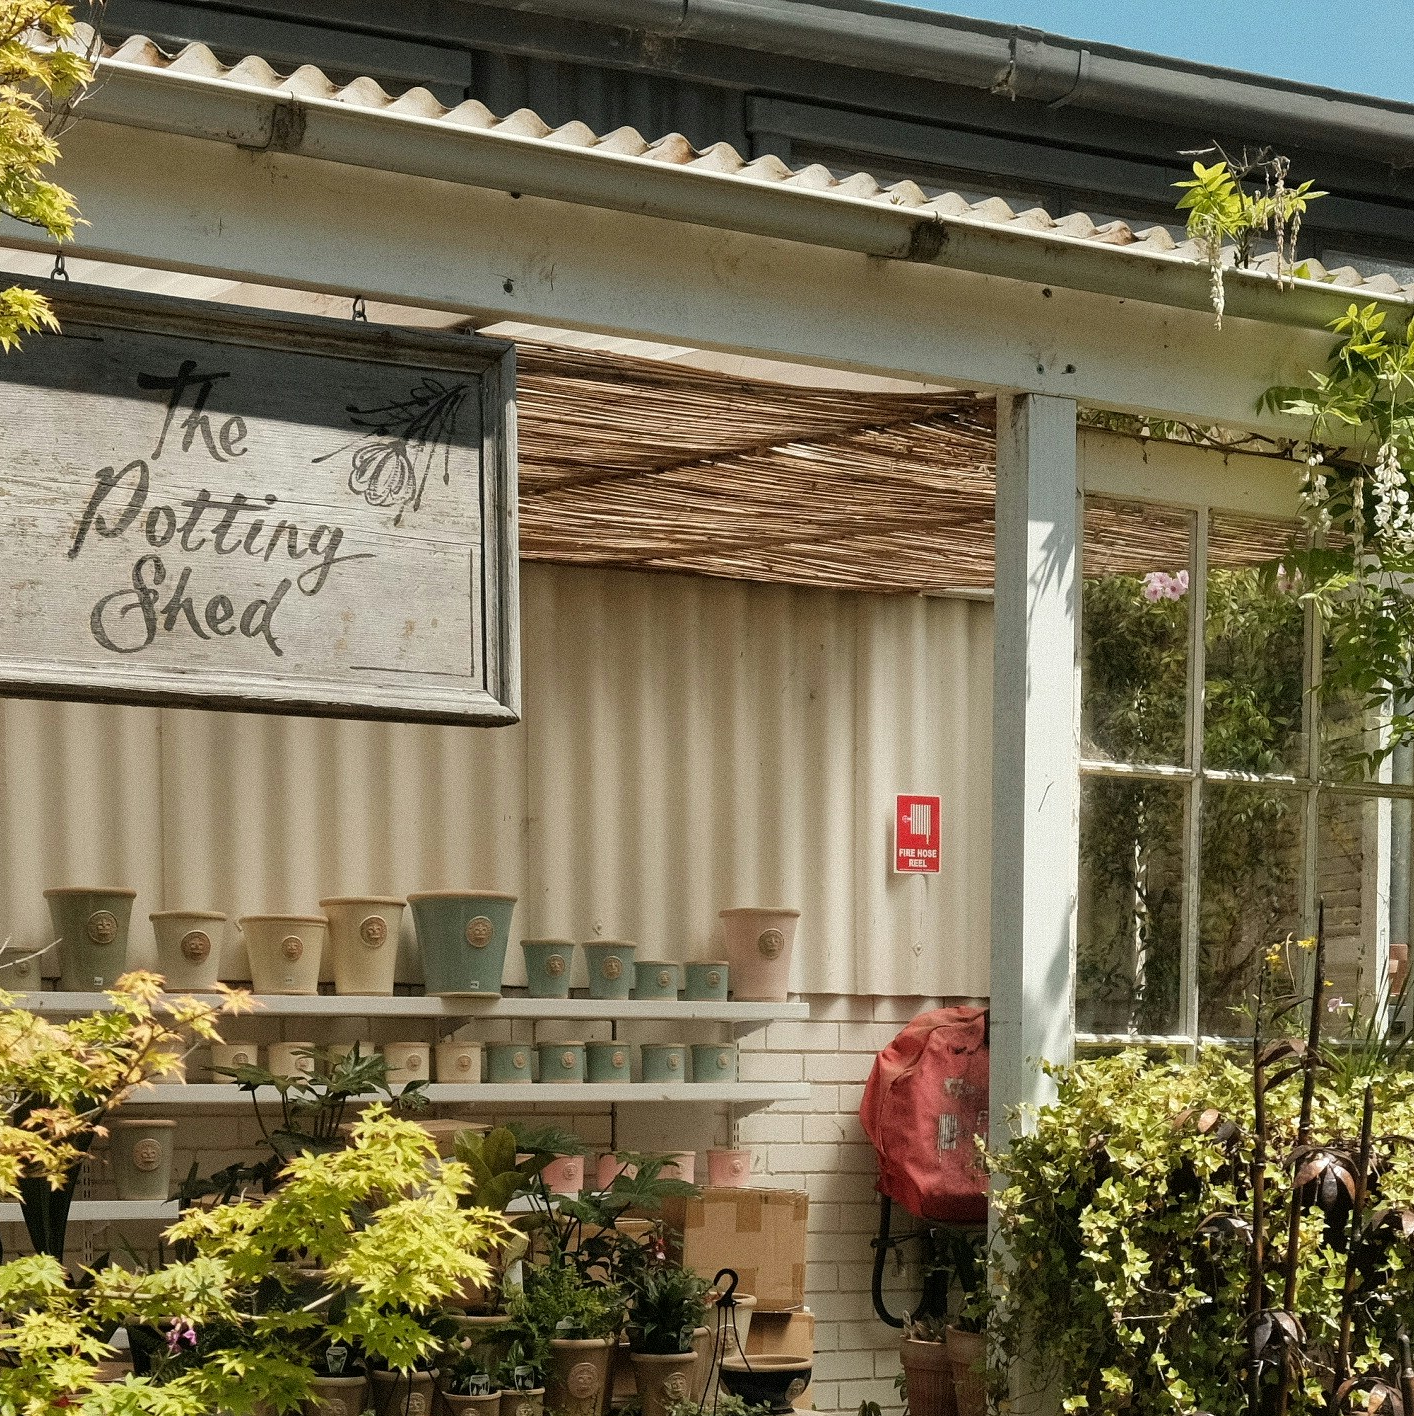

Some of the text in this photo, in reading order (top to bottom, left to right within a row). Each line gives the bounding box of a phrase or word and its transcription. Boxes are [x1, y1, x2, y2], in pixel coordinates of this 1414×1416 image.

[137, 359, 249, 462] The
[67, 459, 376, 597] Potting
[89, 553, 292, 657] Shed
[899, 848, 937, 858] FIRE HOSE
[908, 859, 927, 867] REEL
